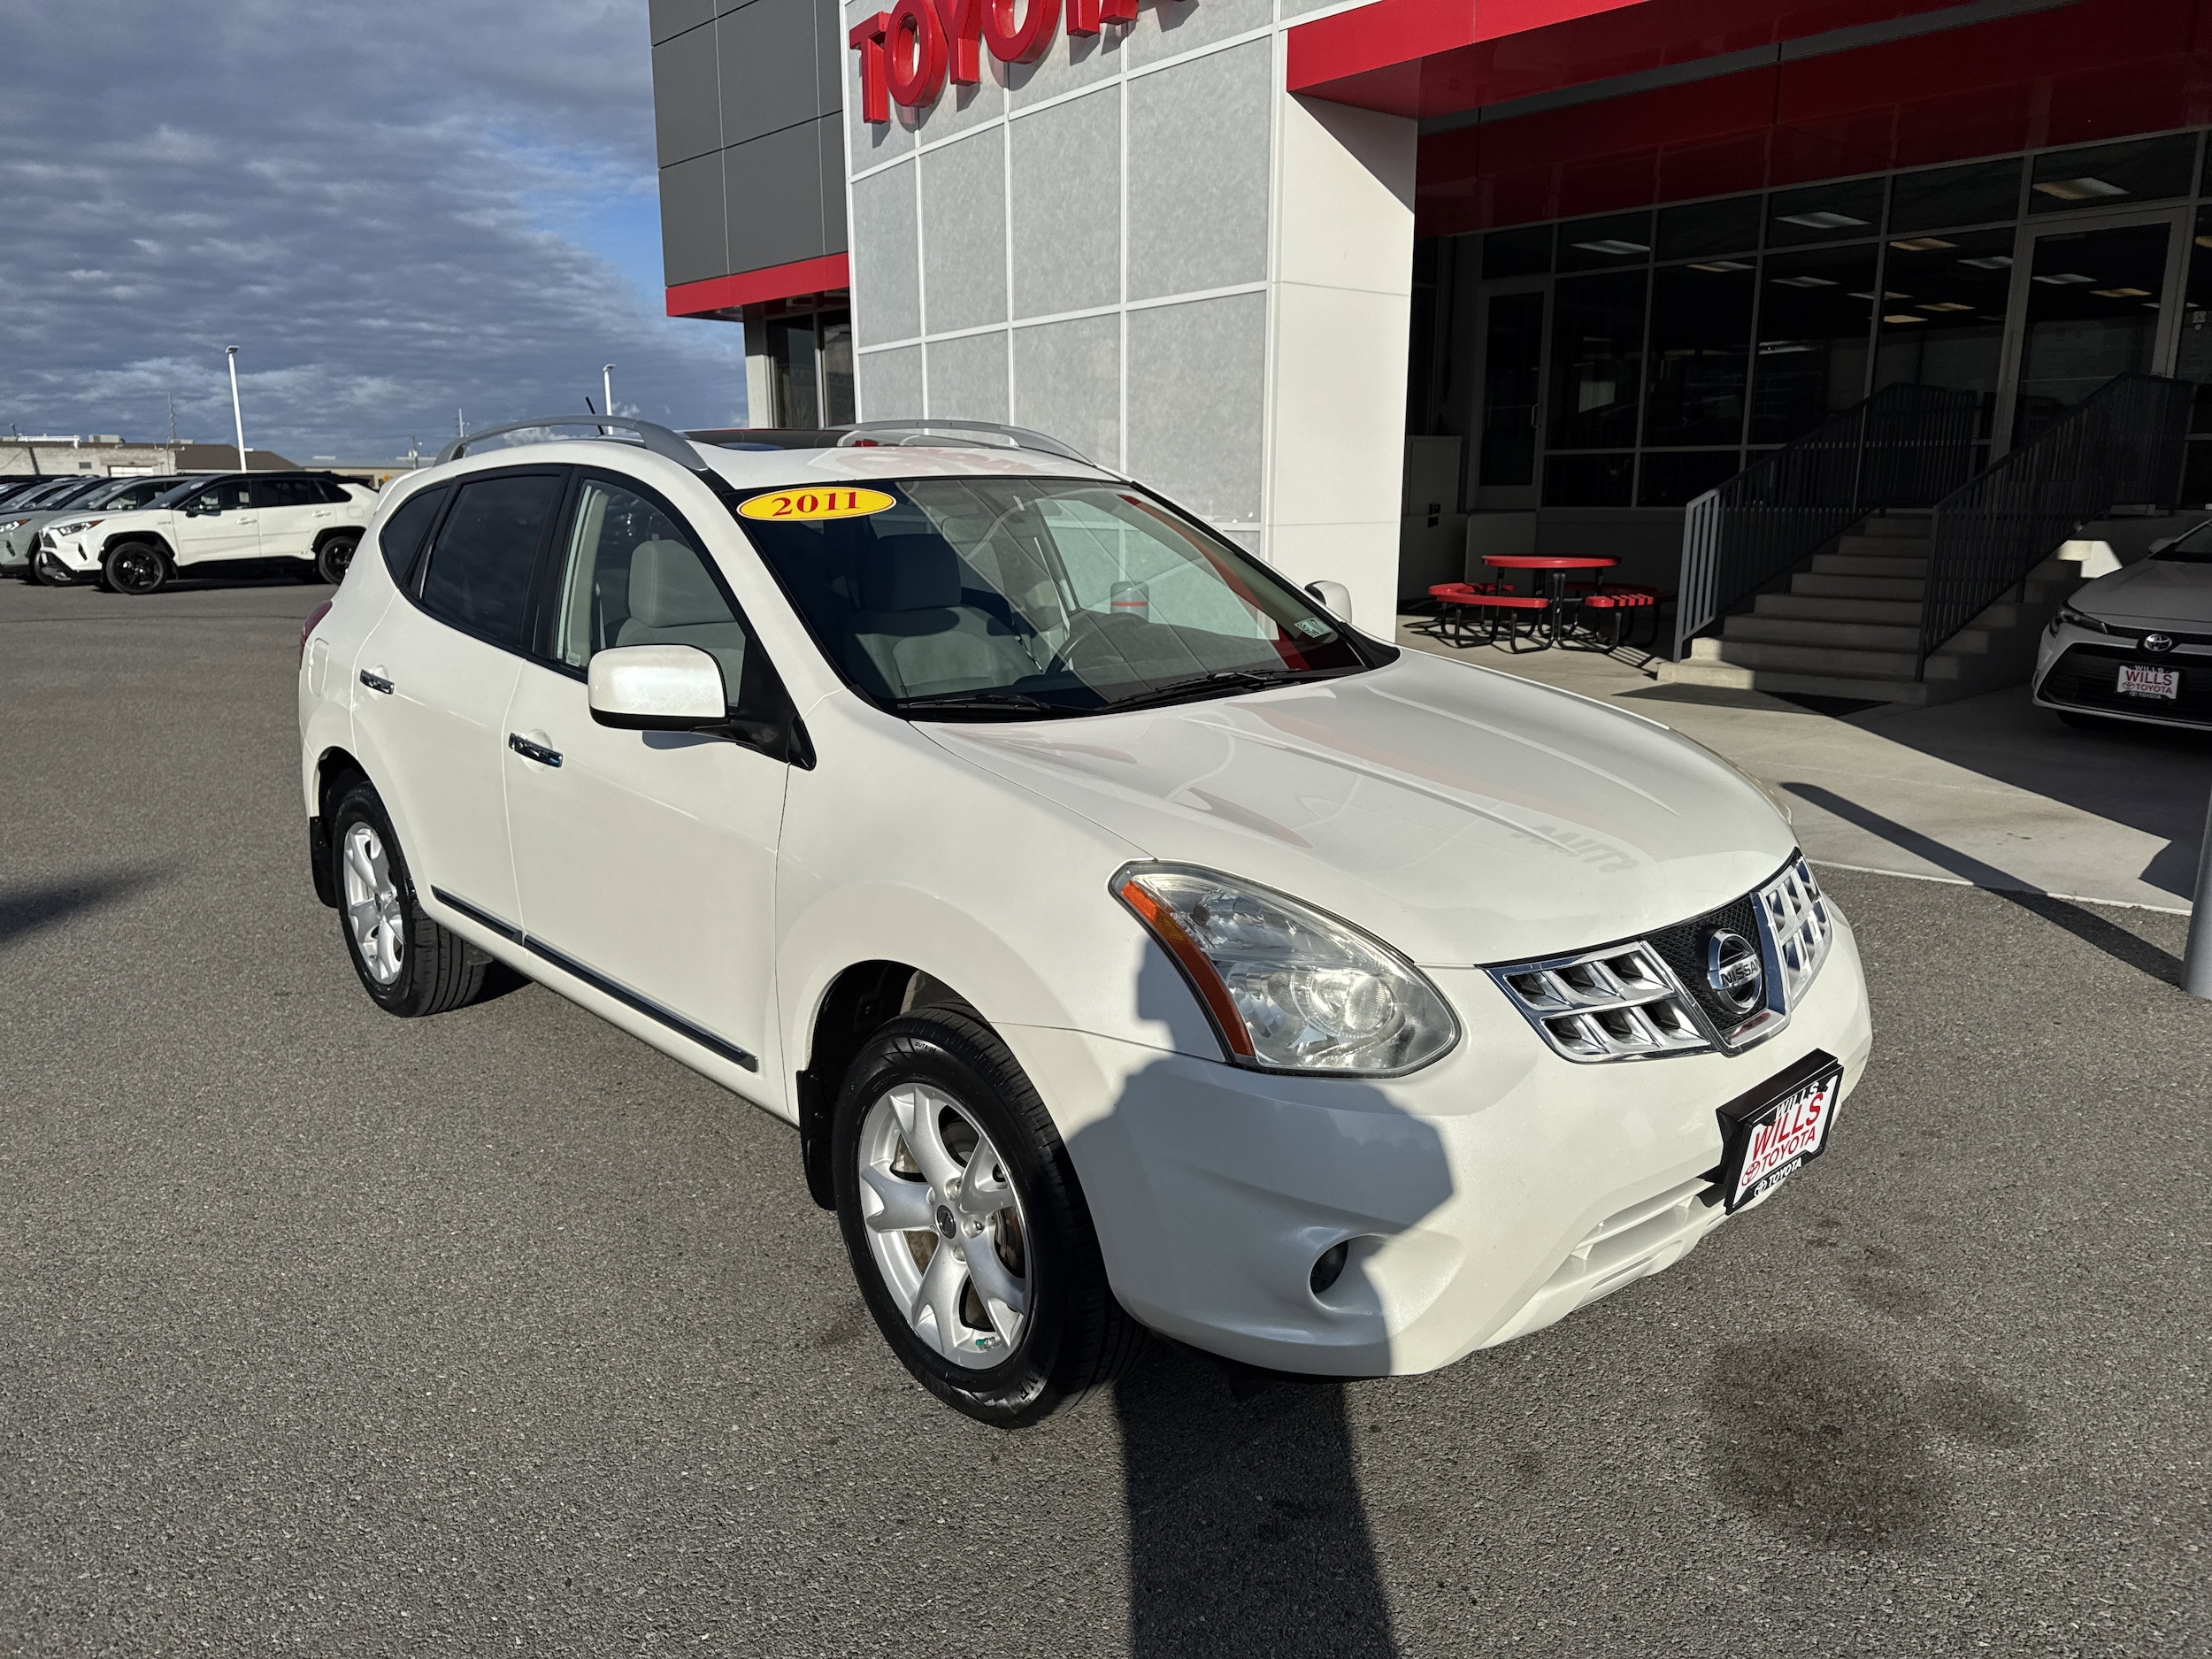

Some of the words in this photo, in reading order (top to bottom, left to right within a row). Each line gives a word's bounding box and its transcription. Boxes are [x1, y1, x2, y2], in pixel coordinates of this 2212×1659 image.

[849, 0, 1187, 124] TOYO
[772, 491, 861, 517] 2011
[2125, 670, 2173, 686] WILLS
[2135, 683, 2173, 695] TOYOTA
[1720, 959, 1762, 987] NISSAN
[1775, 1081, 1820, 1118] WILLS
[1752, 1092, 1824, 1160] WILLS
[1762, 1126, 1816, 1172] TOYOTA
[1768, 1157, 1802, 1187] TOYOTA
